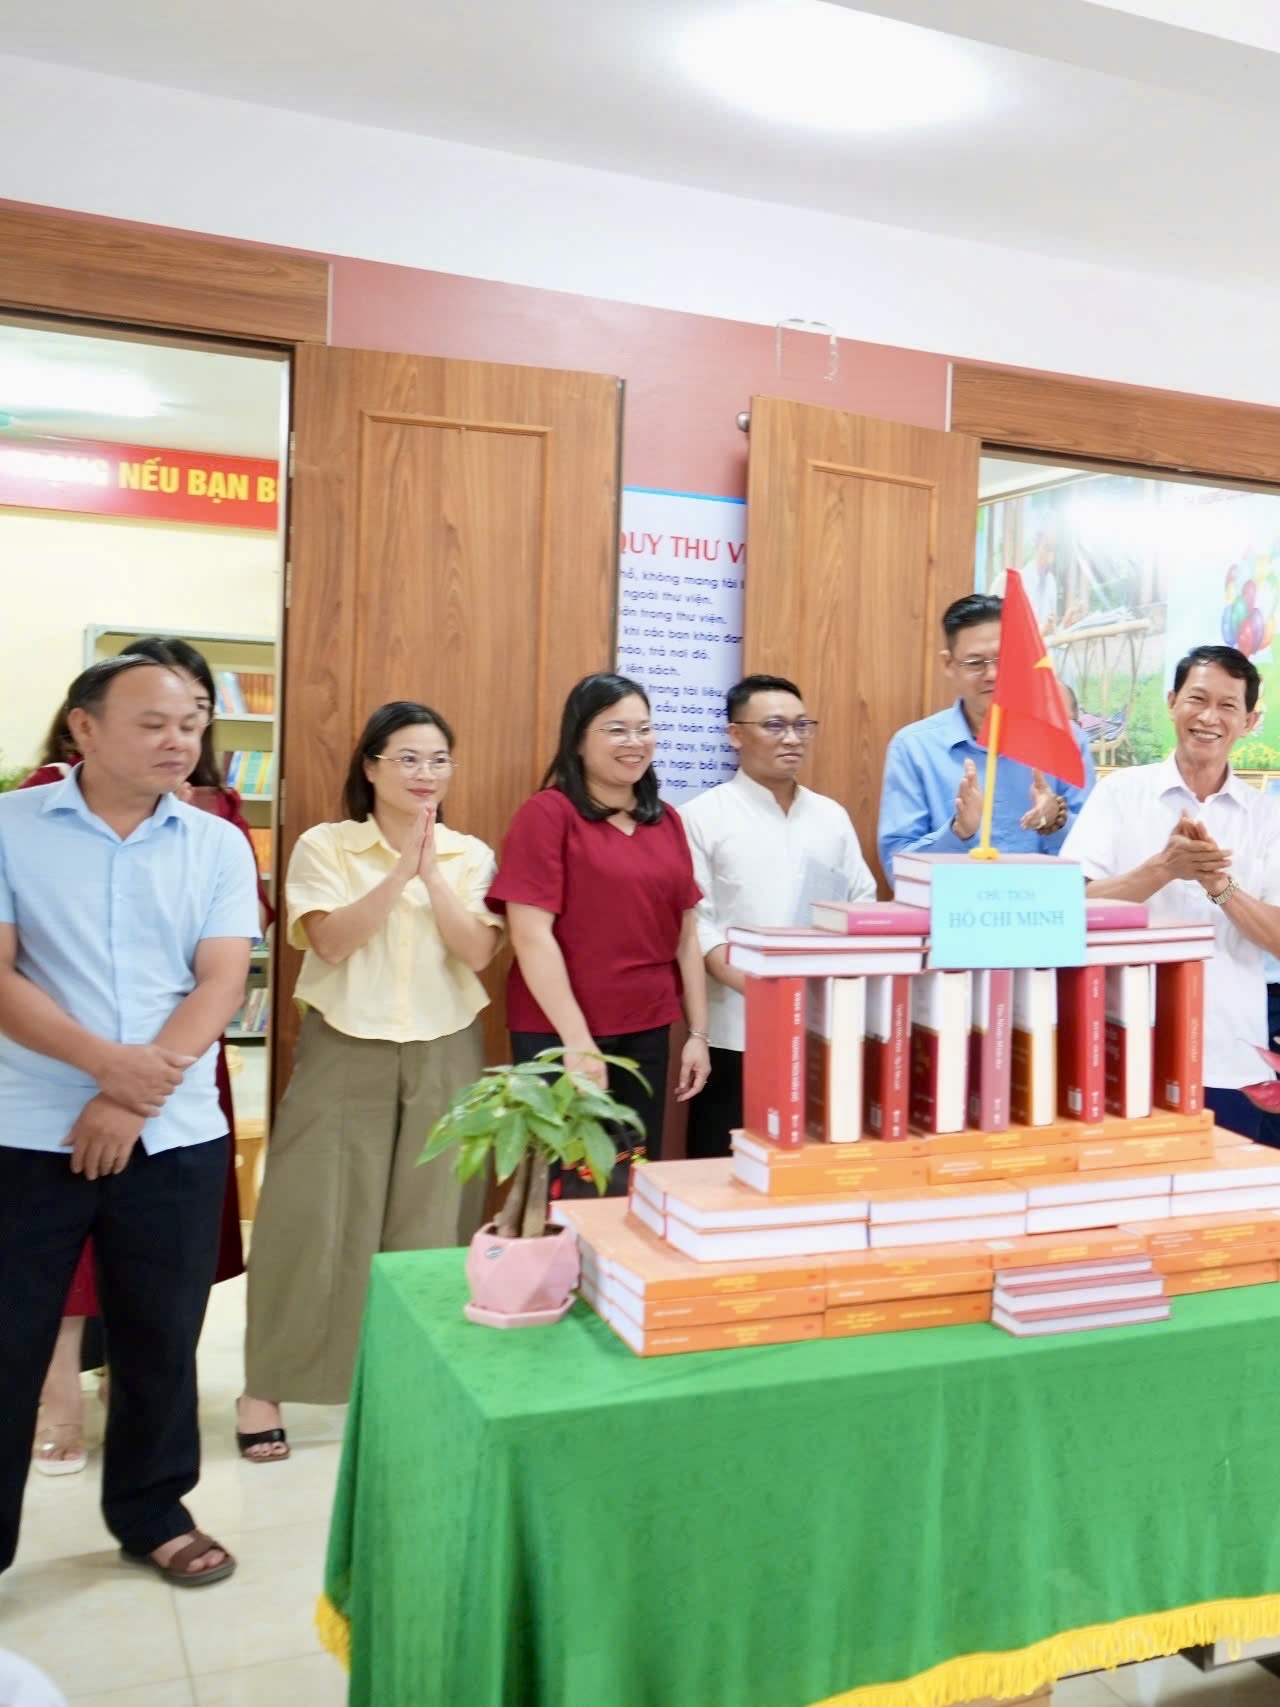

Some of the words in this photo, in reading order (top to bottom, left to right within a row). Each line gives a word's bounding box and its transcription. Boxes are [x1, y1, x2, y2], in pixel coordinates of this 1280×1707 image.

[118, 456, 180, 493] NẾU
[187, 469, 249, 503] BẠN
[256, 476, 279, 503] B
[670, 535, 720, 561] THƯ
[728, 541, 746, 564] V
[683, 576, 718, 590] mang
[644, 627, 665, 638] các
[1015, 910, 1065, 926] MINH
